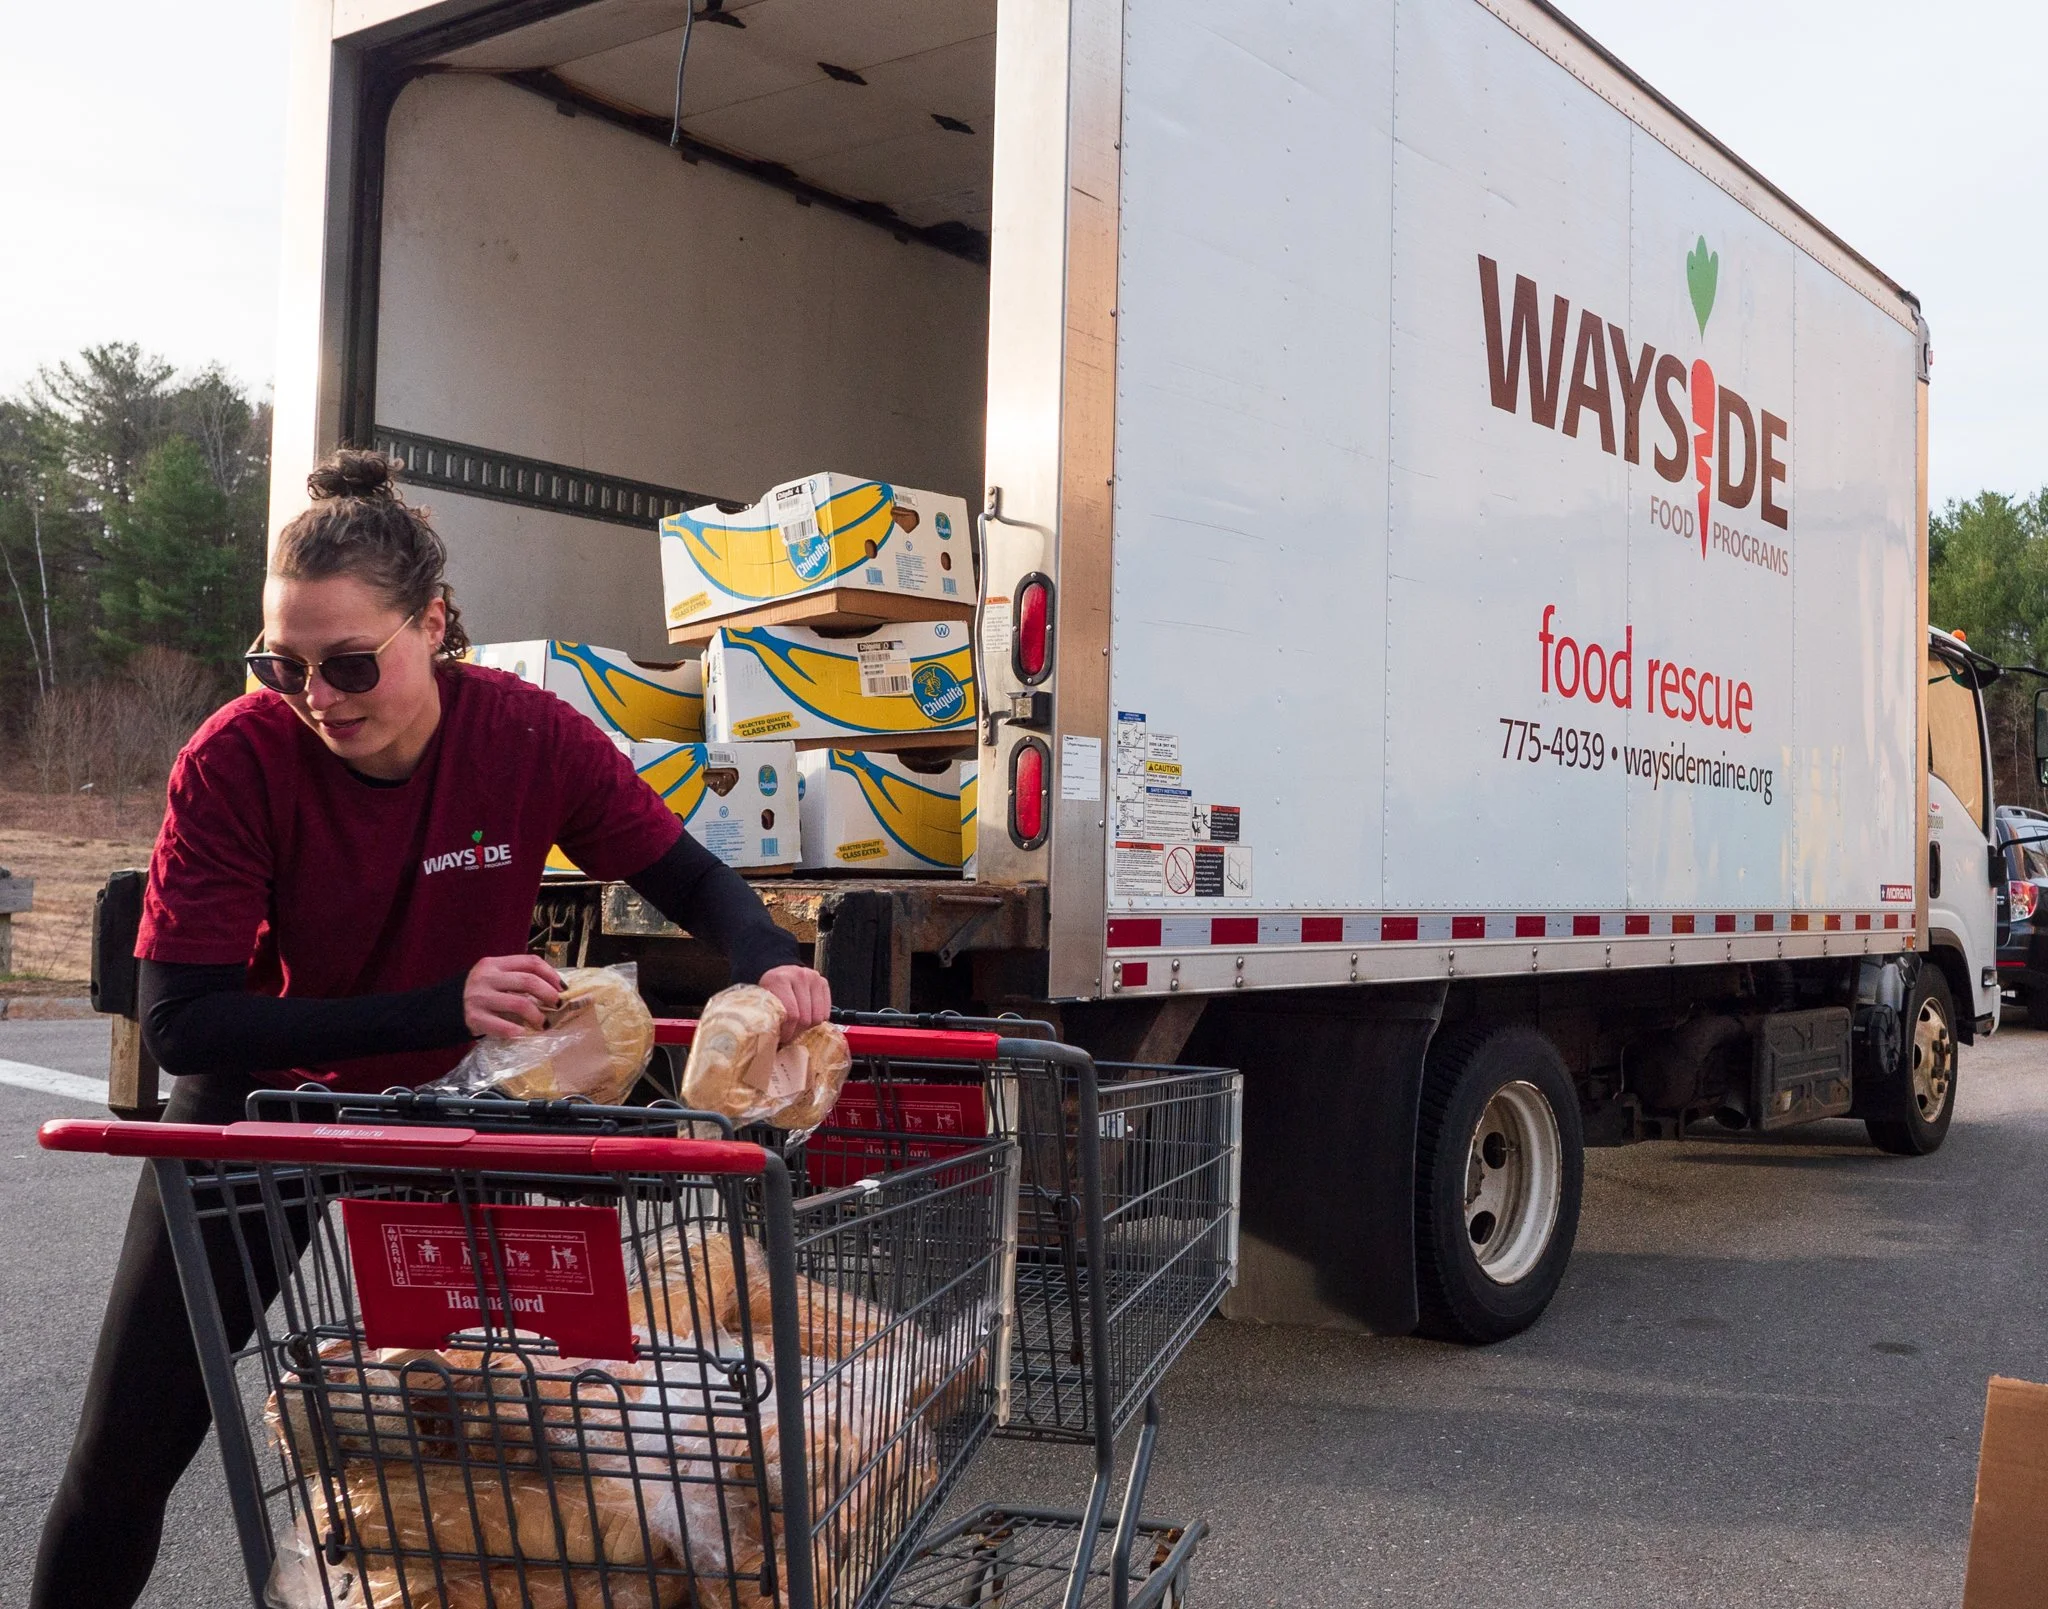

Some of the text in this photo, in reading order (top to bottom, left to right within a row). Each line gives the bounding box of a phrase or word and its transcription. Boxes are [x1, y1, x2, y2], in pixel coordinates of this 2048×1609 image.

[1650, 495, 1789, 577] FOOD PROGRAMS
[796, 539, 830, 577] Chiquita
[1539, 604, 1753, 734] food rescue
[922, 685, 964, 717] Chiquita
[738, 714, 790, 729] SELECTED QUALITY
[742, 721, 792, 737] CLASS EXTRA
[1154, 763, 1180, 774] CAUTION
[1499, 717, 1773, 806] 775-4939 waysidemaine.org
[839, 840, 880, 853] SELECTED QUALITY
[842, 847, 881, 860] CLASS EXTRA
[1886, 887, 1912, 900] MORGAN
[387, 1233, 406, 1285] WARNING
